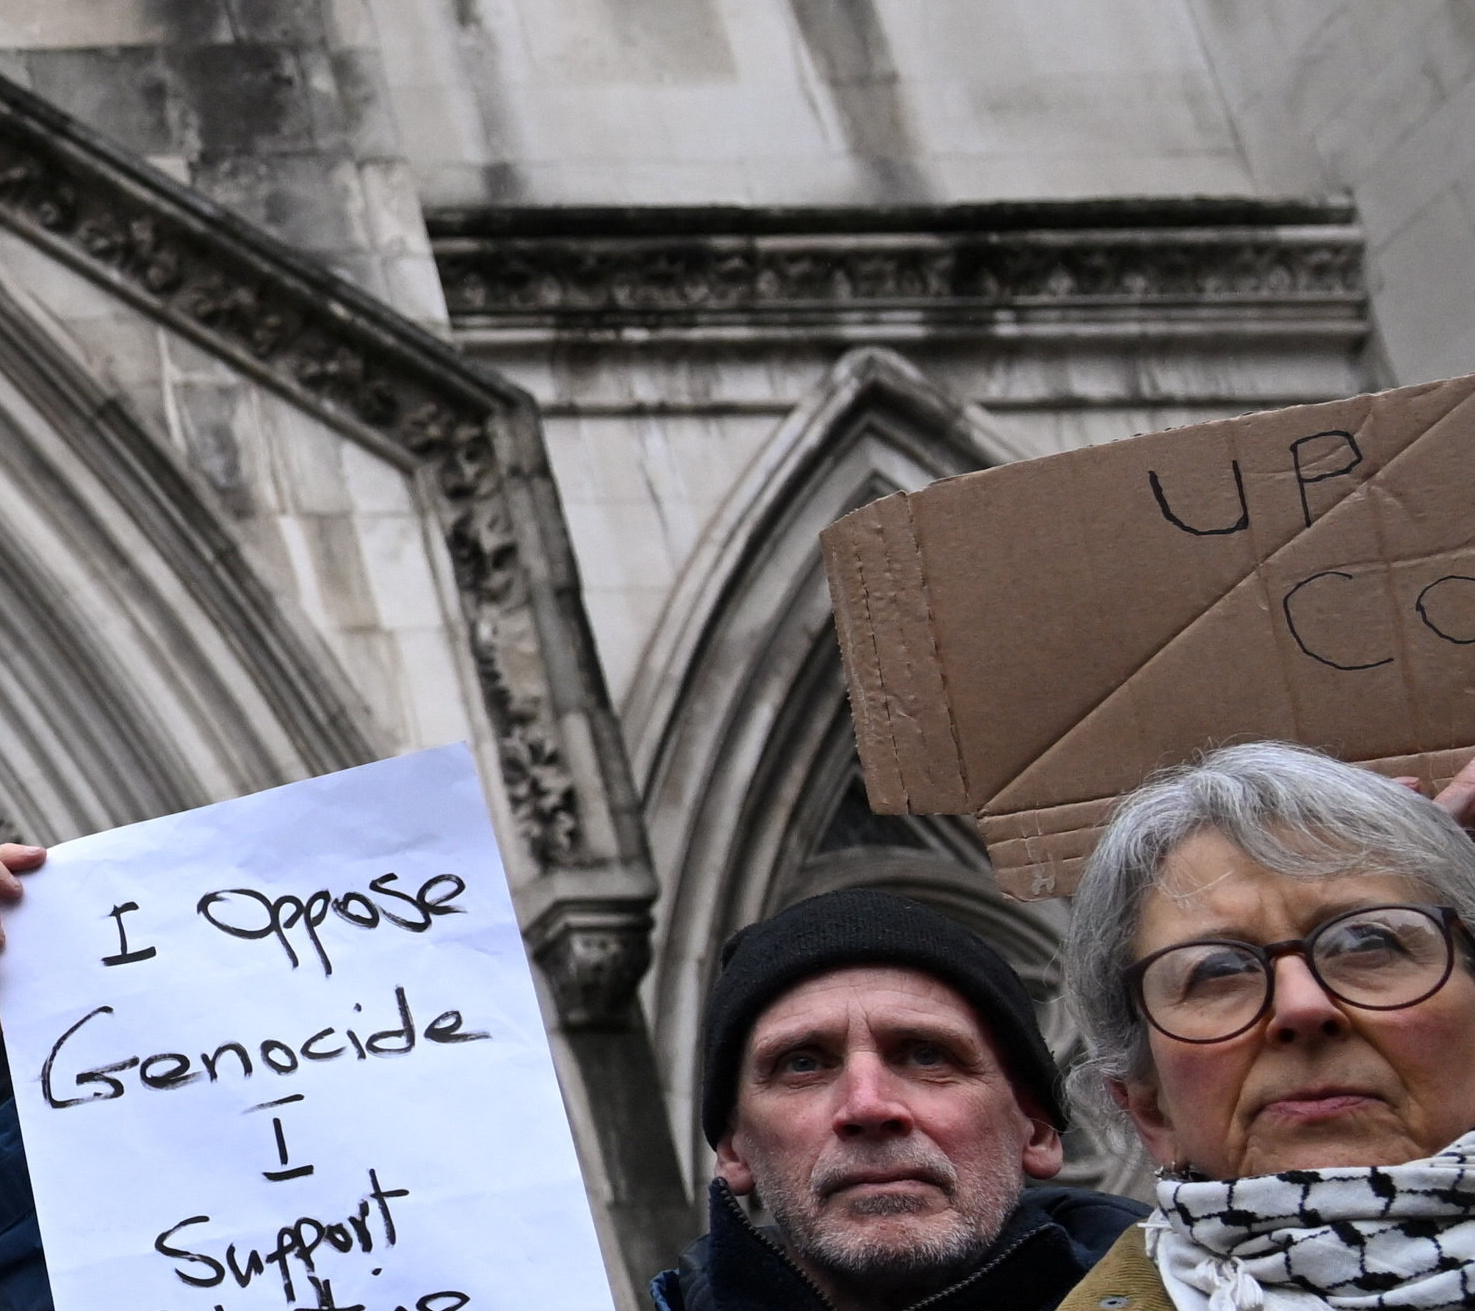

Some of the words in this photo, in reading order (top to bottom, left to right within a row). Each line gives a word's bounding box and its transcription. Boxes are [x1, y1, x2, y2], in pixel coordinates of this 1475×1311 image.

[1148, 430, 1363, 535] UP
[102, 901, 156, 966] I
[43, 985, 491, 1109] Genocide
[243, 1094, 314, 1181] I
